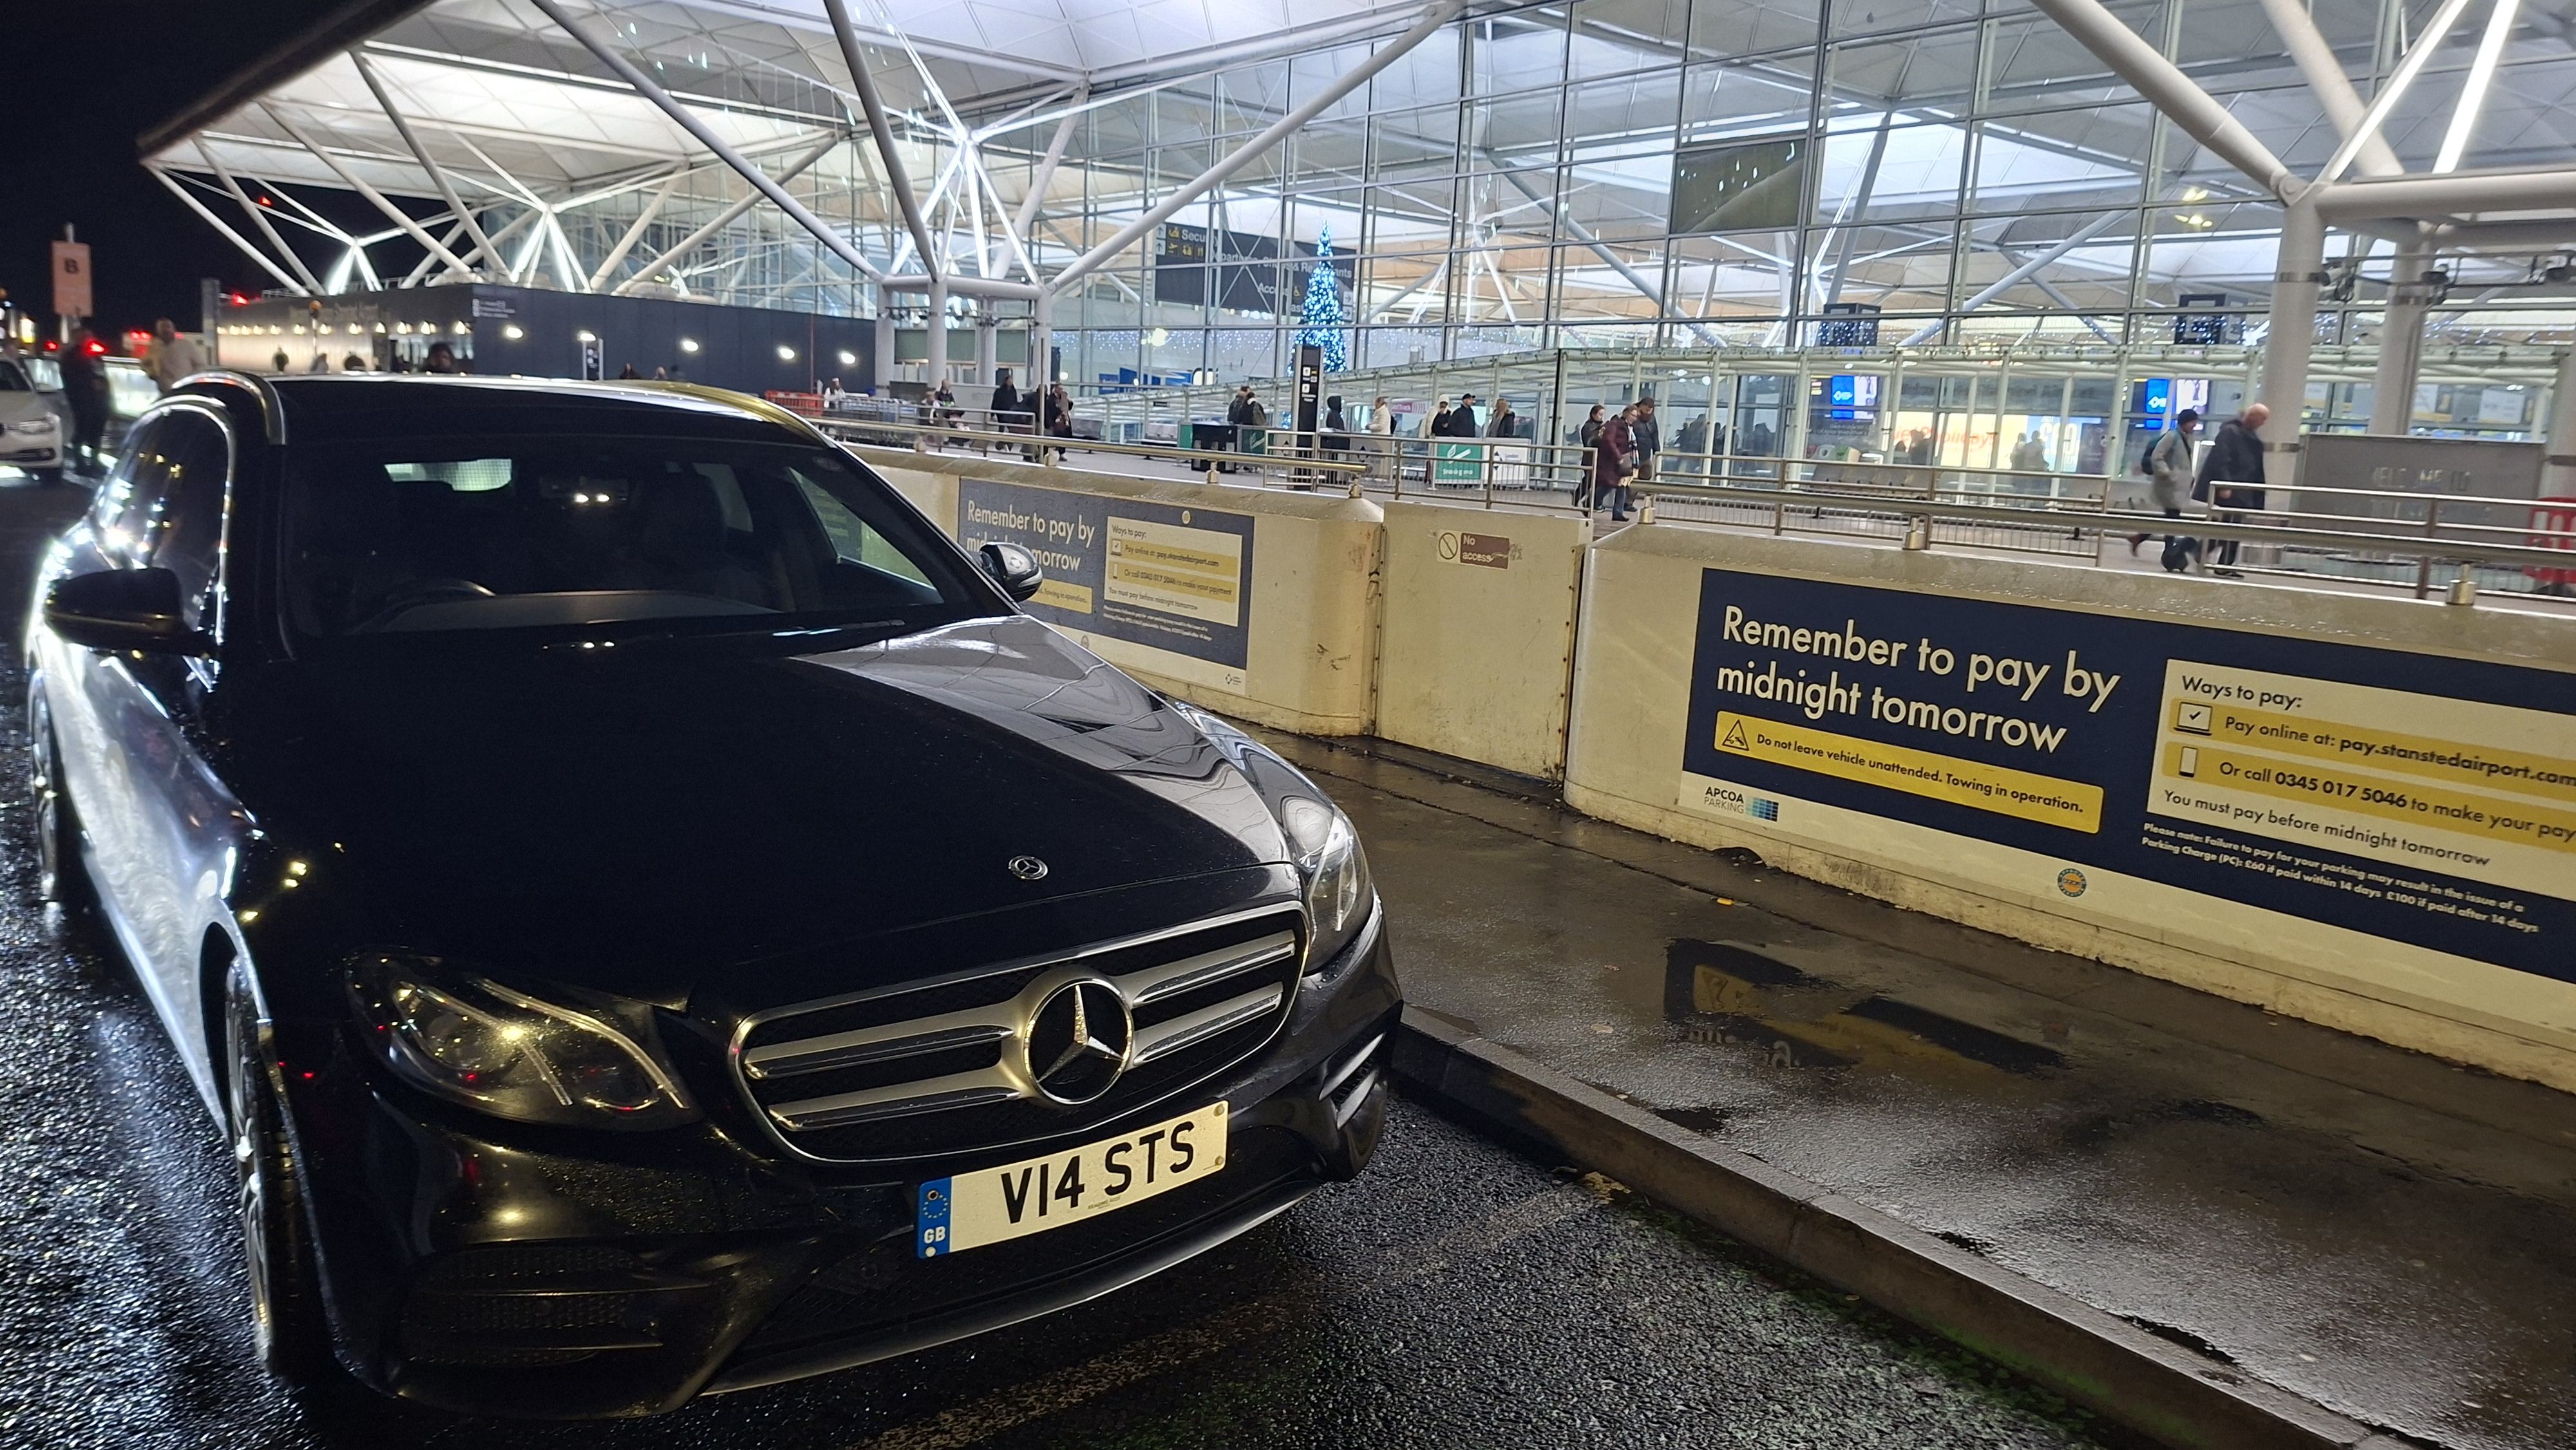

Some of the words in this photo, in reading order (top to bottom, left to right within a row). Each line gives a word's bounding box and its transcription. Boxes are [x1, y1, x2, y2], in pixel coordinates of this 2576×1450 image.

[65, 259, 79, 274] B
[967, 500, 1030, 531] Remember
[1033, 513, 1046, 533] to
[1049, 520, 1074, 545] pay
[1078, 514, 1095, 549] by
[1463, 535, 1475, 545] No
[1021, 543, 1081, 571] morrow
[1462, 551, 1493, 563] access
[1723, 605, 1908, 667] Remember
[1918, 637, 1955, 675] to
[1967, 652, 2050, 702] pay
[2063, 650, 2121, 713] by
[1717, 661, 1862, 720] midnight
[1871, 686, 2067, 753] tomorrow
[2182, 675, 2233, 699] Ways
[2237, 684, 2254, 701] to
[2259, 689, 2302, 711] pay:
[1756, 733, 1772, 748] Do
[1774, 736, 1792, 751] not
[1793, 739, 1823, 758] leave
[1826, 748, 1866, 767] vehicle
[1868, 757, 1943, 785] unattended.
[1946, 773, 1993, 800] Towing
[1995, 782, 2008, 796] in
[2011, 788, 2084, 815] operation.
[2225, 715, 2254, 737] Pay
[2259, 722, 2309, 744] online
[2313, 733, 2335, 748] at:
[2339, 737, 2576, 788] pay.stanstedairport.com
[1703, 796, 1745, 814] PARKING
[1705, 786, 1745, 805] APCOA
[2219, 761, 2240, 777] Or
[2244, 764, 2271, 784] call
[2275, 771, 2318, 793] 0345
[2322, 778, 2356, 799] 017
[2360, 786, 2407, 809] 5046
[2410, 798, 2428, 812] to
[2434, 804, 2485, 823] make
[2488, 814, 2535, 829] your
[2164, 789, 2190, 806] You
[2195, 799, 2230, 814] must
[2233, 807, 2264, 823] pay
[2268, 809, 2319, 833] before
[2324, 824, 2398, 848] midnight
[2401, 838, 2490, 866] tomorrow
[2142, 836, 2181, 854] Parking
[2181, 845, 2217, 863] Charge
[2219, 853, 2244, 868] (PC):
[2244, 860, 2266, 872] £60
[2266, 863, 2275, 875] if
[2275, 867, 2301, 881] paid
[2302, 872, 2337, 889] within
[2339, 880, 2353, 891] 14
[2353, 884, 2382, 899] days
[2385, 891, 2416, 905] £100
[2416, 898, 2427, 909] if
[2427, 901, 2457, 916] paid
[2457, 908, 2489, 922] after
[2490, 914, 2506, 925] 14
[2506, 918, 2540, 934] days
[2143, 822, 2175, 837] Please
[2204, 836, 2240, 852] Failure
[2240, 843, 2253, 854] to
[2253, 848, 2275, 860] pay
[2275, 851, 2293, 862] for
[2293, 855, 2320, 869] your
[2321, 862, 2366, 881] parking
[2367, 872, 2394, 886] may
[2395, 879, 2429, 892] result
[2430, 884, 2442, 895] in
[2444, 888, 2464, 901] the
[2465, 891, 2497, 907] issue
[2498, 899, 2514, 911] of
[2514, 904, 2525, 914] a
[1001, 1155, 1085, 1224] V14
[1104, 1121, 1195, 1196] STS
[923, 1226, 946, 1243] GB
